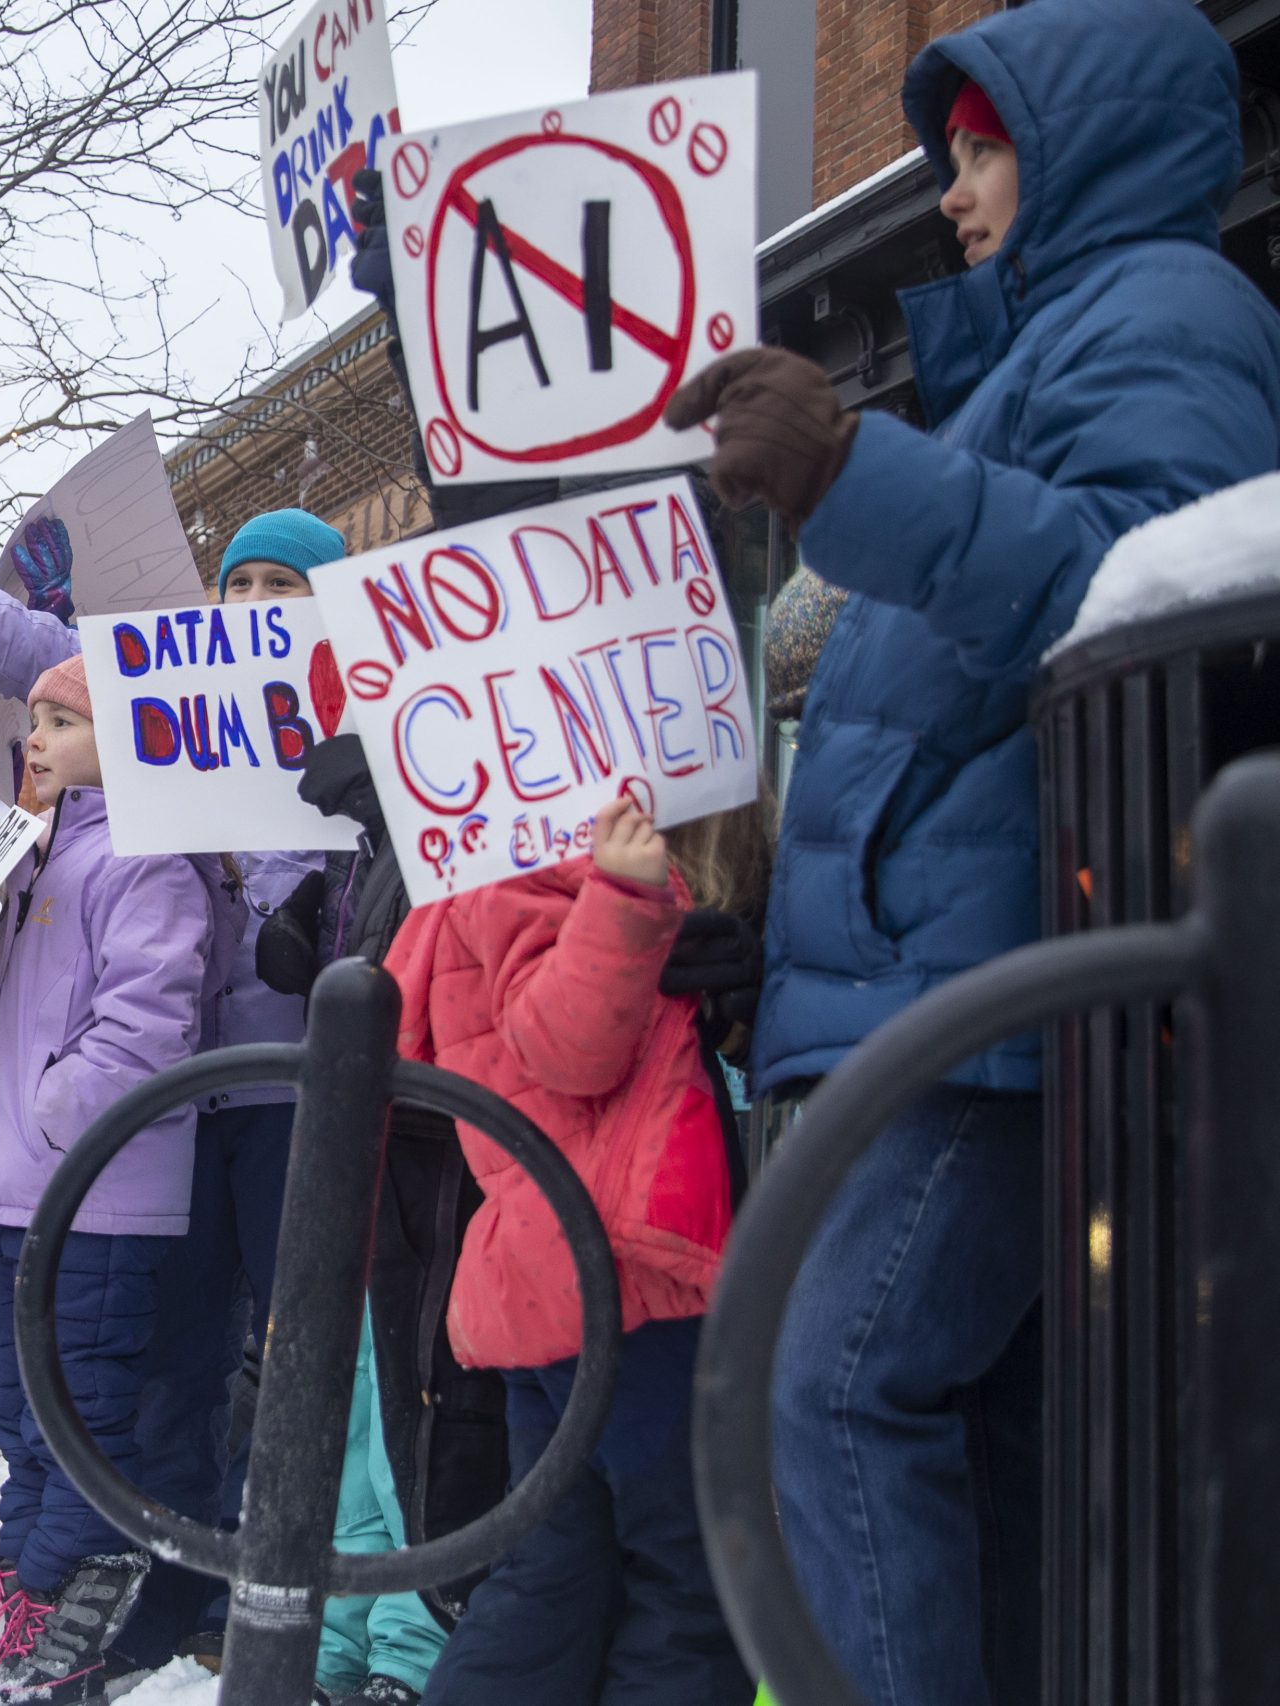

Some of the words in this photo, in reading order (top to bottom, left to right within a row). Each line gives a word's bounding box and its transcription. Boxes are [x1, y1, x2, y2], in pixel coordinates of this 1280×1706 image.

[263, 38, 306, 147] YOU
[314, 0, 374, 82] CAN
[272, 75, 353, 229] DRINK
[467, 197, 613, 412] AI
[112, 608, 236, 677] DATA
[250, 606, 291, 658] IS
[363, 543, 508, 667] NO
[510, 493, 712, 621] DATA
[392, 624, 746, 816] CENTER
